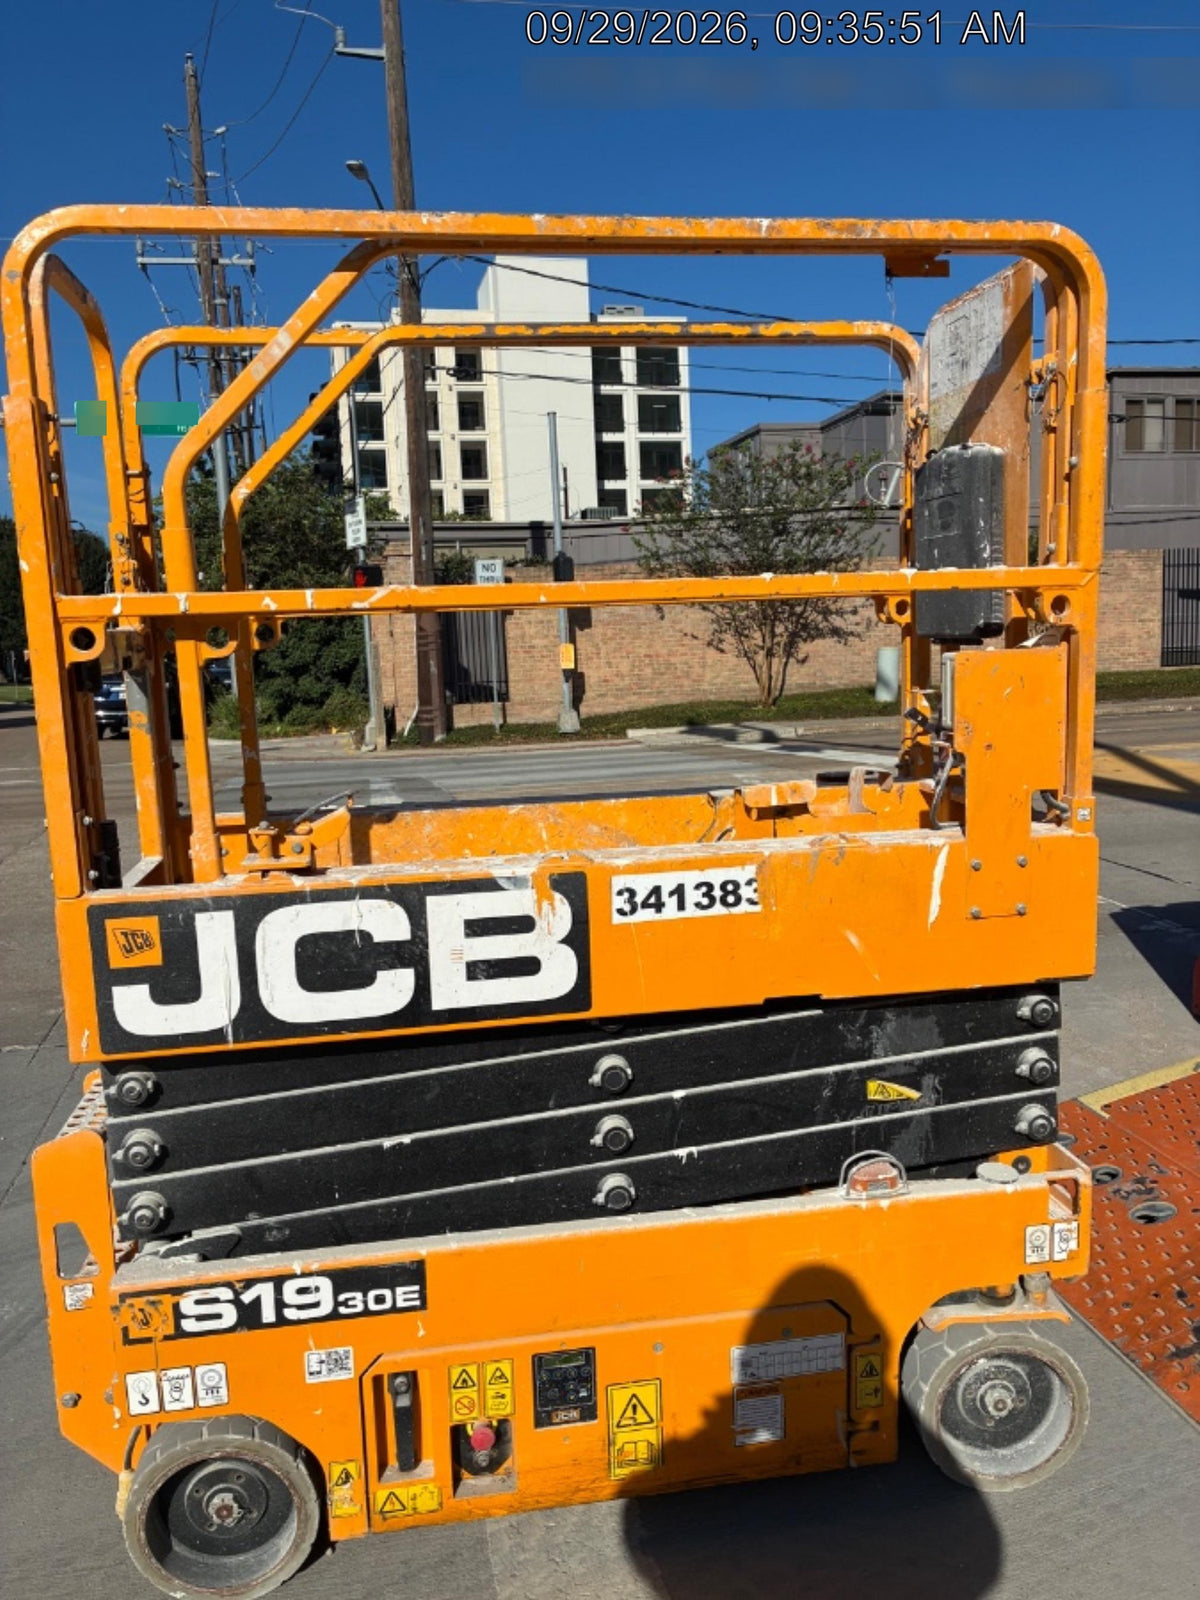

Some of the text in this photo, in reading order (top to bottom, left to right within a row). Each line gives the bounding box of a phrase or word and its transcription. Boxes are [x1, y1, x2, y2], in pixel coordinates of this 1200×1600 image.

[481, 563, 497, 573] NO
[119, 930, 153, 955] JCB
[111, 889, 579, 1037] JCB
